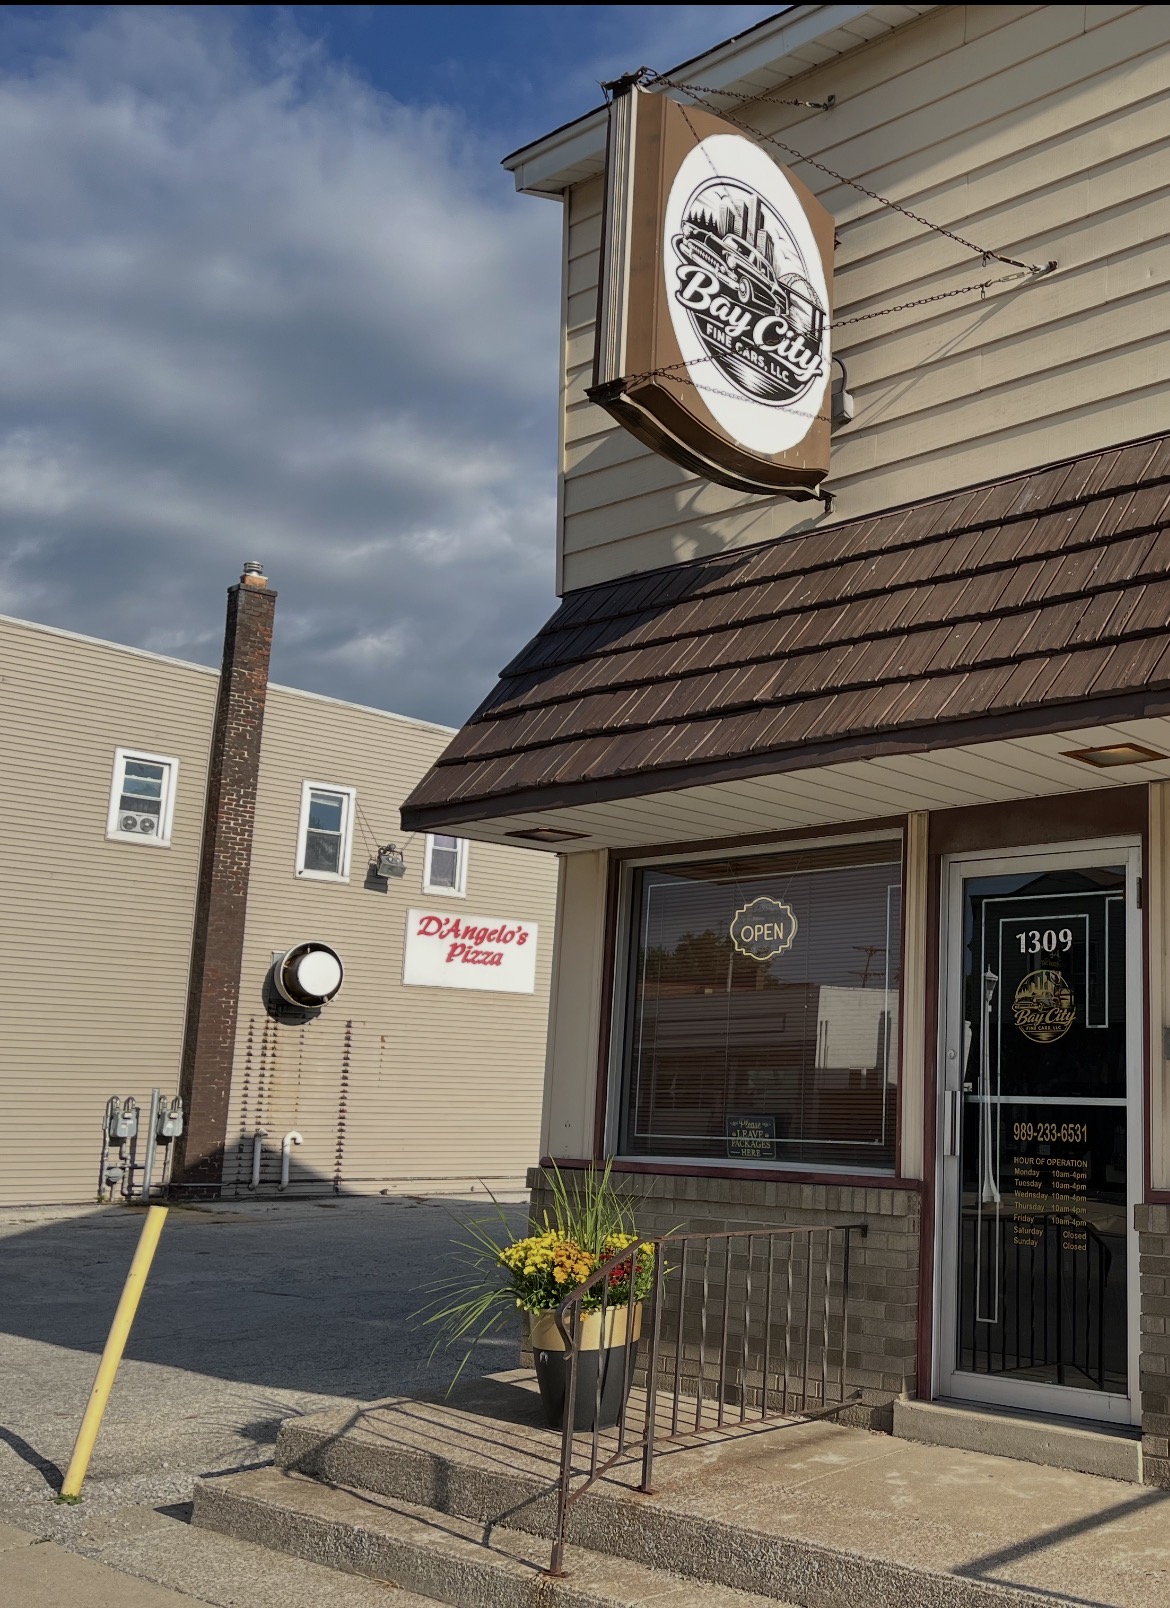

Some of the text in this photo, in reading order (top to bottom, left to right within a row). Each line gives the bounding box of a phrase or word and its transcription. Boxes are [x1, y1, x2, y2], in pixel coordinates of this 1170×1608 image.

[676, 265, 824, 384] Bay City
[706, 325, 790, 383] FINE CARS, LLC
[416, 915, 529, 946] D'Angelo's
[741, 922, 784, 942] OPEN
[1015, 928, 1073, 954] 1309
[445, 942, 504, 967] Pizza
[1014, 1007, 1076, 1026] Bay City
[738, 1118, 762, 1130] Please
[736, 1129, 764, 1139] LEAVE
[1013, 1122, 1088, 1143] 989-233-6531
[731, 1139, 771, 1149] PACKAGES
[741, 1148, 761, 1157] HERE
[1014, 1156, 1088, 1168] HOUR OF OPERATION
[1014, 1168, 1087, 1181] Monday 10am-4pm
[1014, 1179, 1087, 1192] Tuesday 10am-4pm
[1014, 1190, 1087, 1203] Wednsday 10am-4pm
[1014, 1202, 1087, 1215] Thursday 10am-4pm
[1013, 1214, 1087, 1227] Friday 10am-4pm
[1013, 1226, 1087, 1240] Saturday Closed
[1013, 1237, 1087, 1251] Sunday Closed
